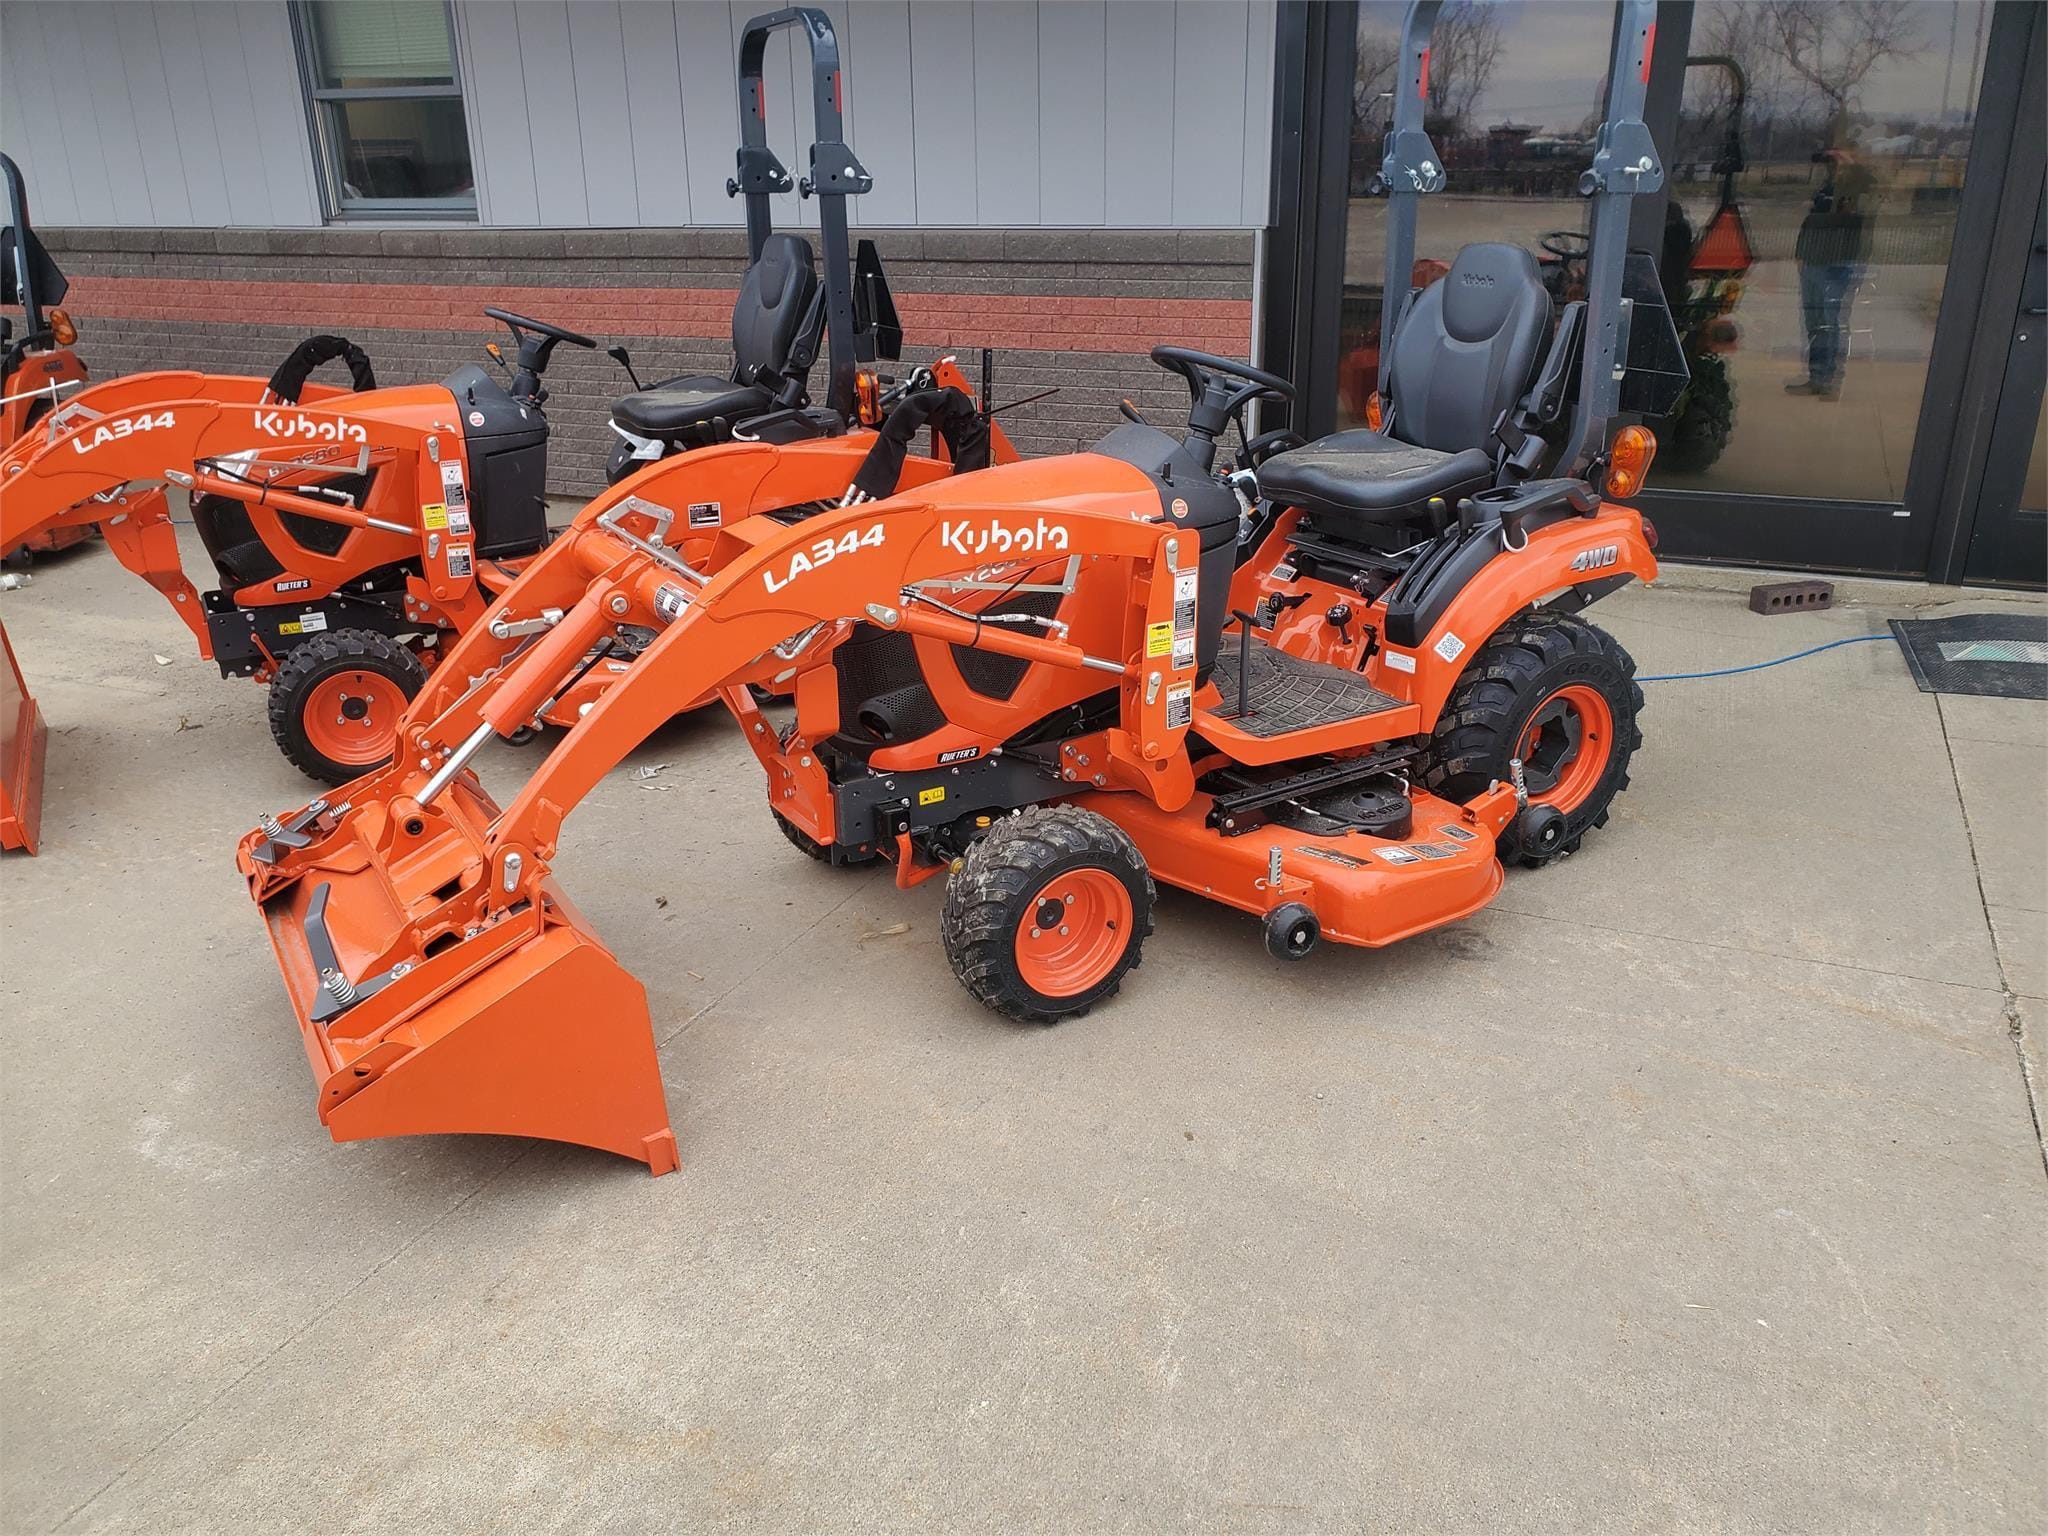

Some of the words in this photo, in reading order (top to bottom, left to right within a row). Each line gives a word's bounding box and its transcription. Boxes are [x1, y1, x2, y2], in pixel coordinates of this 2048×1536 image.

[72, 411, 176, 454] LA344
[254, 410, 367, 443] Kubota
[942, 517, 1068, 555] Kubota
[763, 523, 885, 594] LA344
[1570, 545, 1618, 572] 4WD
[276, 580, 309, 592] RUETER'S
[940, 747, 978, 763] RUETER'S
